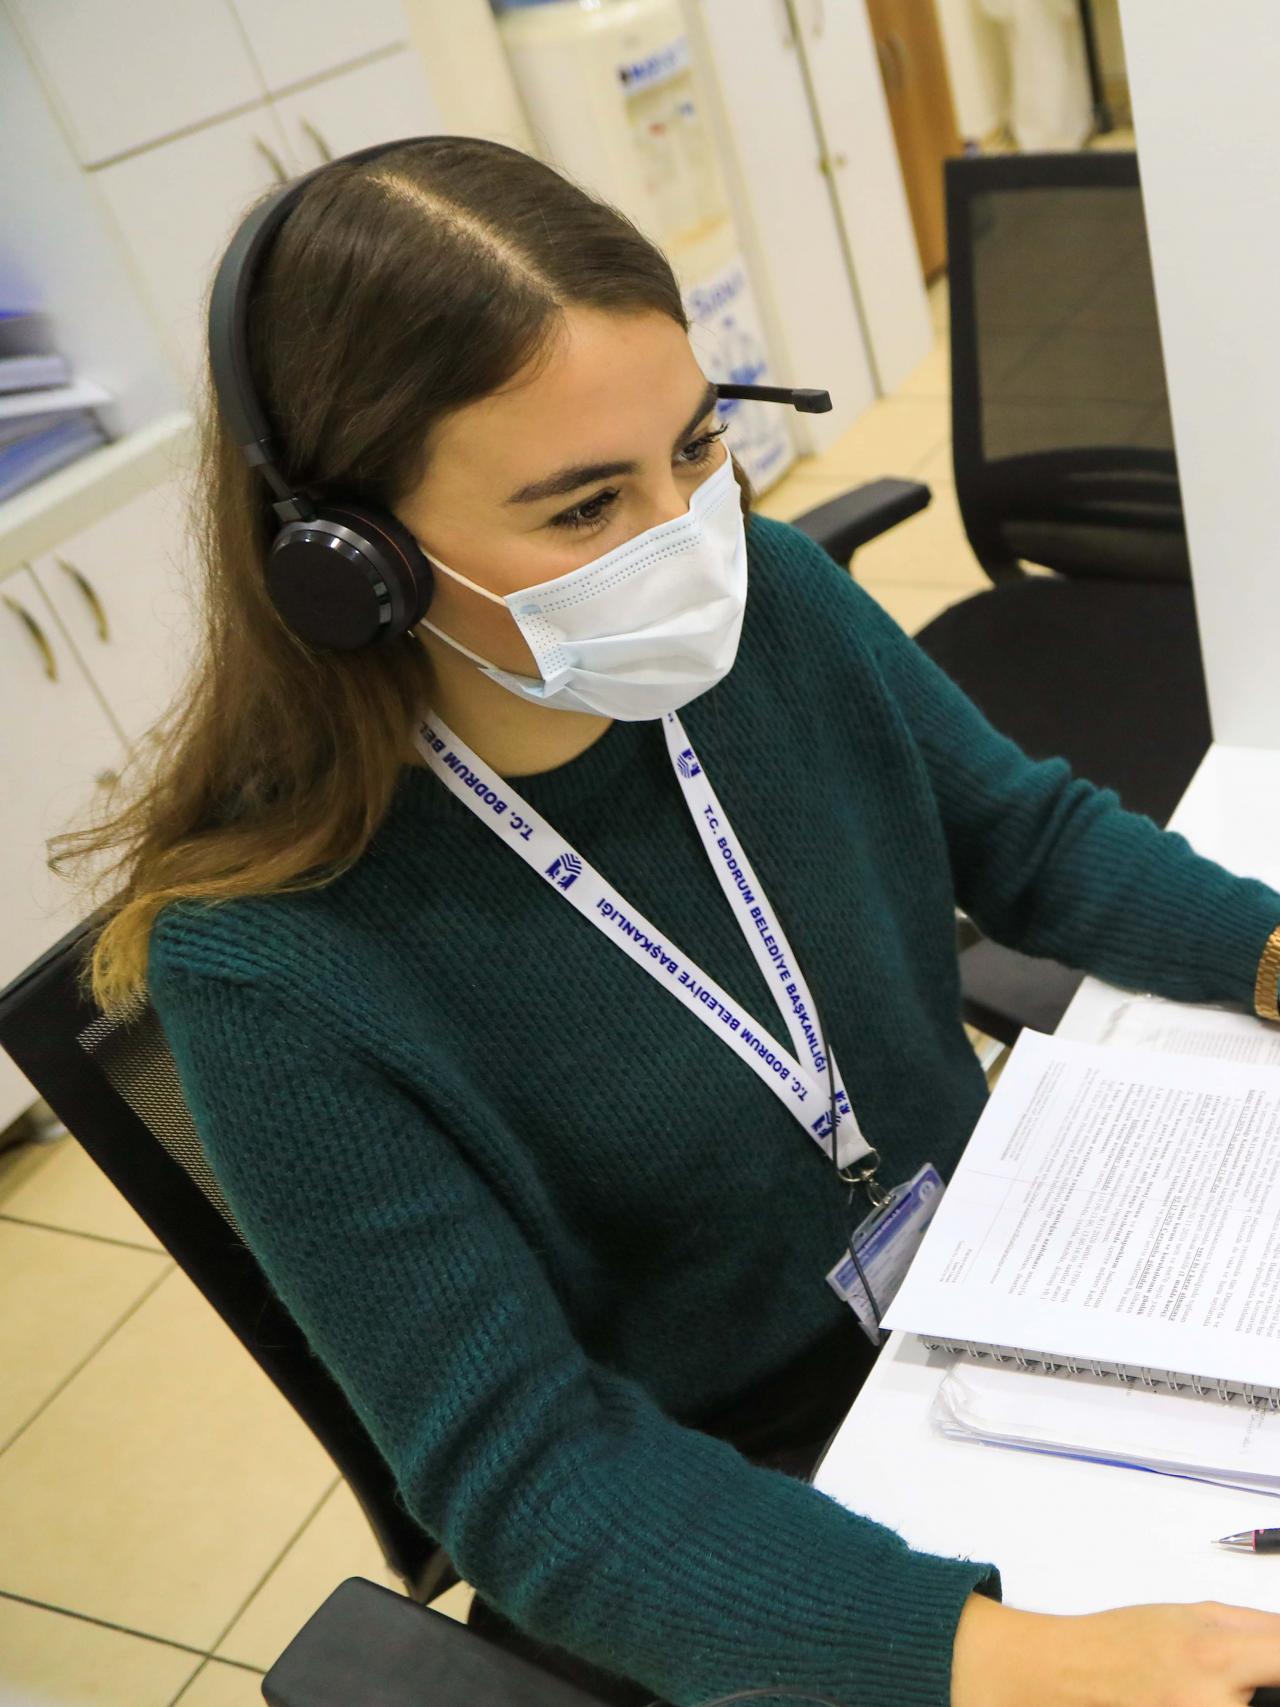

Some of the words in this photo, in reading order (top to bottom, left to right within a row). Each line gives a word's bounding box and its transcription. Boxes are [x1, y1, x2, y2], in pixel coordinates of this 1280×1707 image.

[443, 751, 508, 815] BODRUM
[509, 811, 534, 841] T.C.
[596, 898, 678, 974] BAŞKANLIĞI
[702, 804, 718, 835] T.C.
[716, 836, 755, 905] BODRUM
[749, 906, 790, 979] BELEDİYE
[786, 980, 827, 1073] BAŞKANLIĞI
[677, 970, 740, 1030] BELEDİYE
[740, 1028, 790, 1080] BODRUM
[791, 1077, 807, 1101] T.C.
